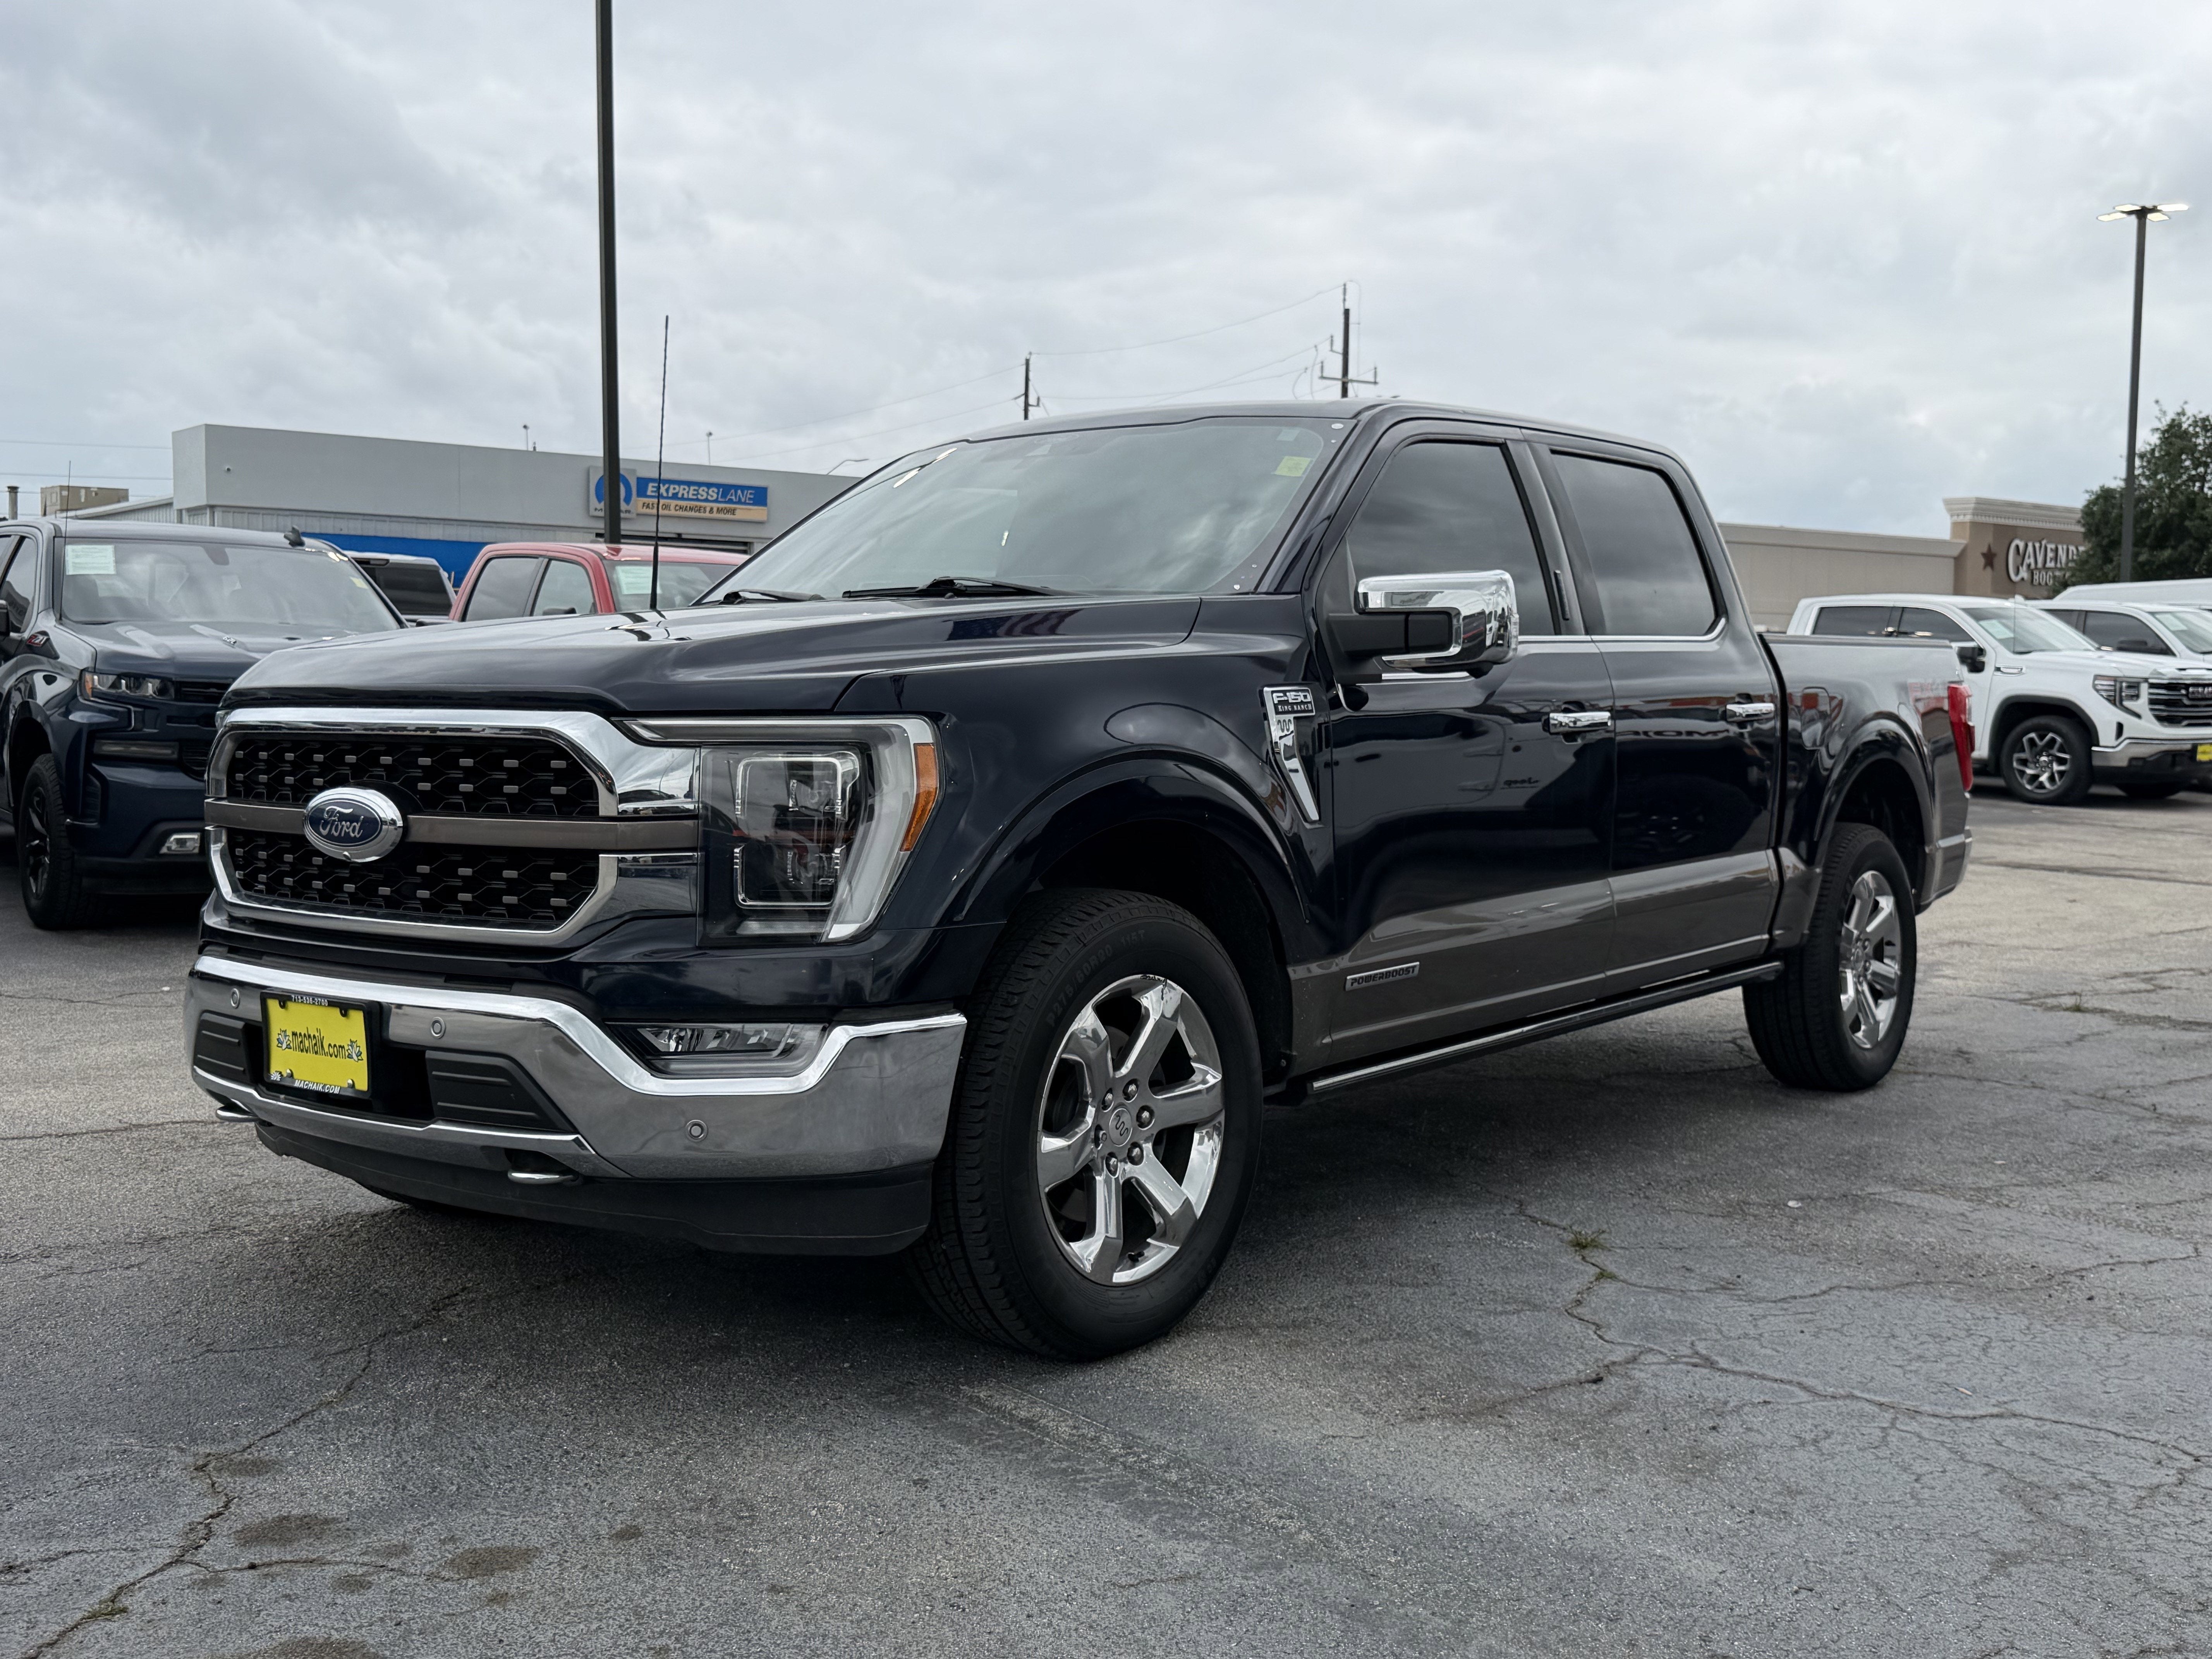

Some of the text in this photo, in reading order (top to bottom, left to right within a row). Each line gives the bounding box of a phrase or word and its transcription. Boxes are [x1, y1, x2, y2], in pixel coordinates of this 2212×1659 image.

[641, 502, 659, 511] FAS
[674, 505, 707, 515] CHANGES
[709, 507, 714, 515] &
[716, 507, 737, 516] MORE
[2008, 538, 2087, 582] CAVEND
[319, 805, 363, 838] Ford
[1350, 965, 1417, 987] POWERBOOST
[292, 1027, 346, 1060] machaik.com
[294, 1079, 341, 1094] MACHAIK.COM
